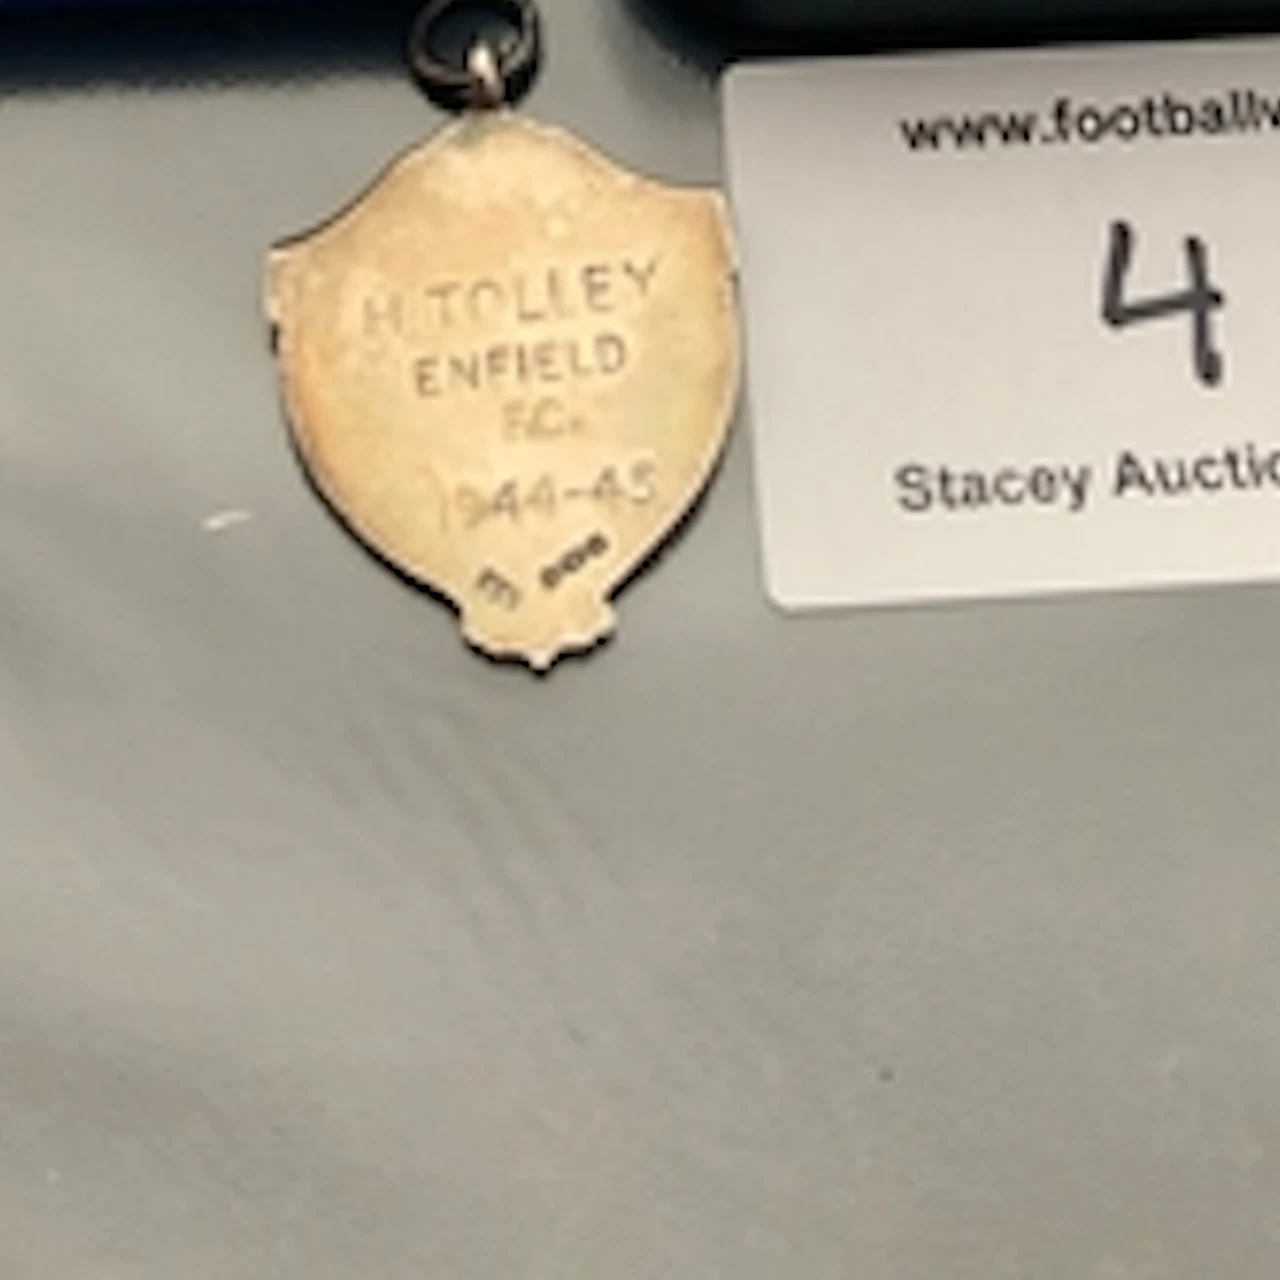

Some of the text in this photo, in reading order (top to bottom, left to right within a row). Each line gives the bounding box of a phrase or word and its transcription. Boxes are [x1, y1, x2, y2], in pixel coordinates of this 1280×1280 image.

[423, 252, 660, 326] TOLLEY
[412, 332, 628, 397] ENFIELD
[893, 460, 1091, 512] Stacey
